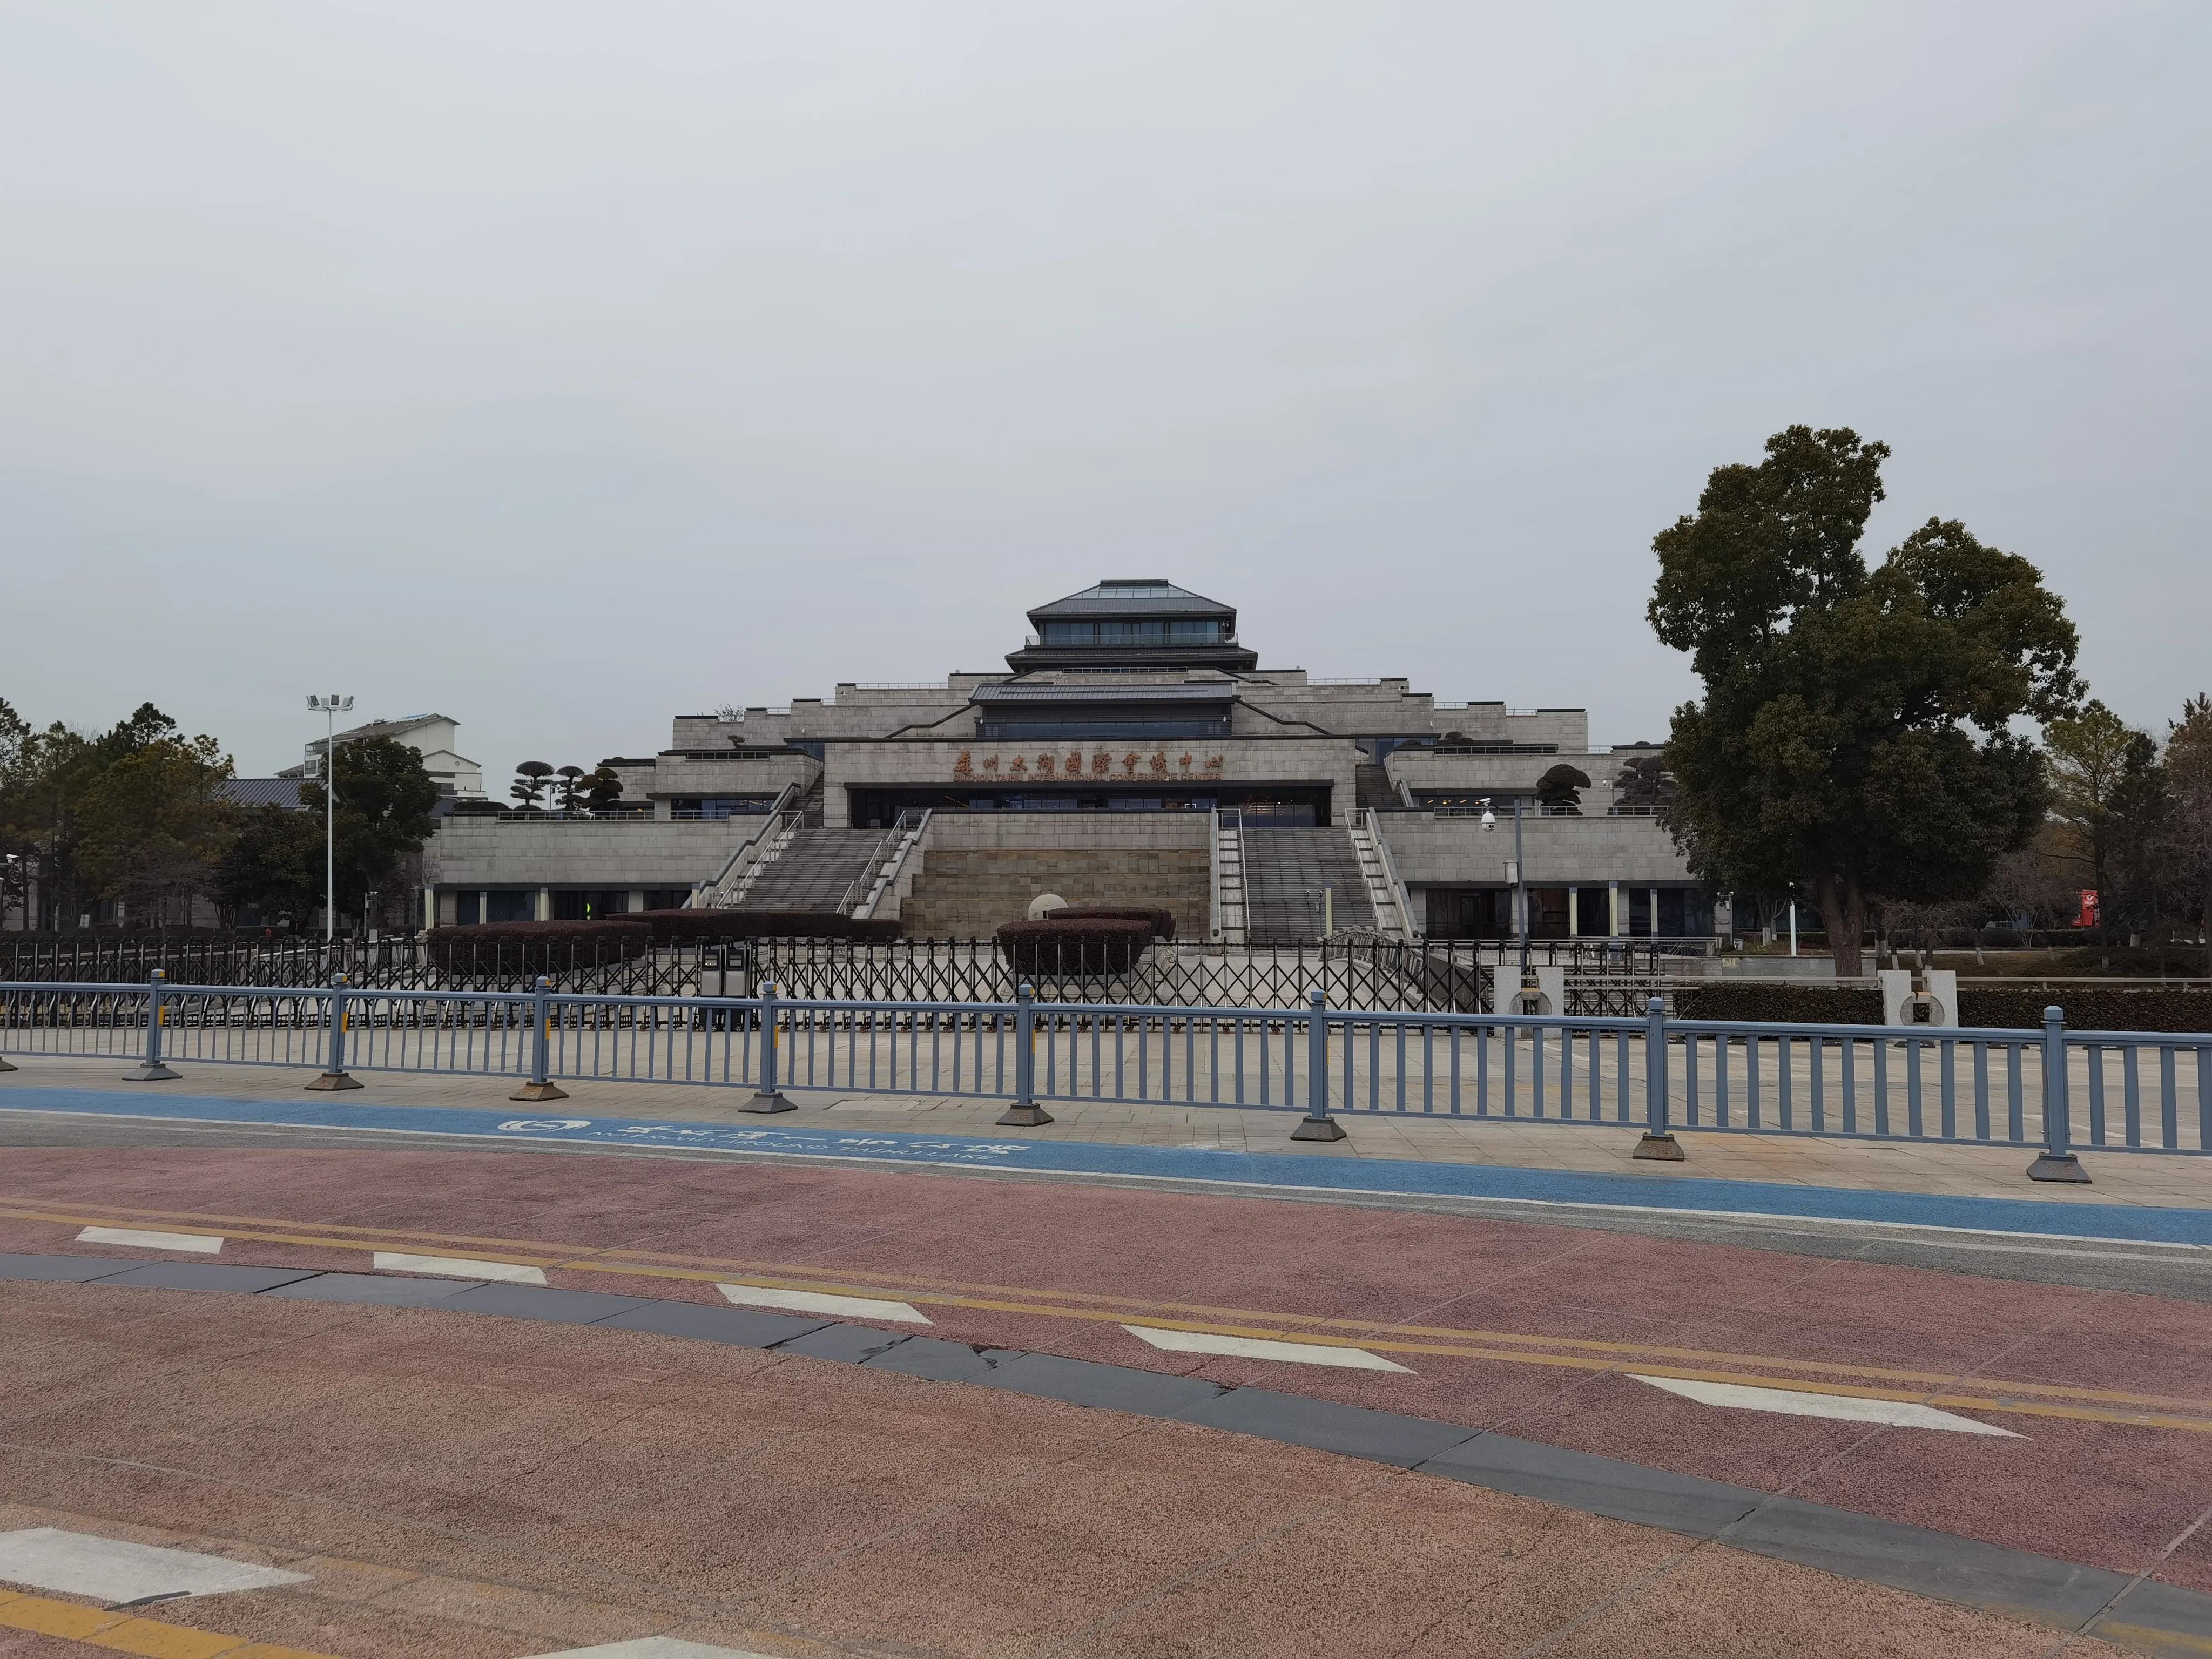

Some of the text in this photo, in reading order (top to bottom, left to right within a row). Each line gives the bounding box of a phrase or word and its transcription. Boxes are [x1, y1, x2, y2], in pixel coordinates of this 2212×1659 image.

[953, 774, 993, 782] SUZHOU
[1028, 773, 1105, 781] INTERNATIONAL
[1110, 773, 1177, 781] CONFERENCE
[1181, 773, 1222, 781] CENTER
